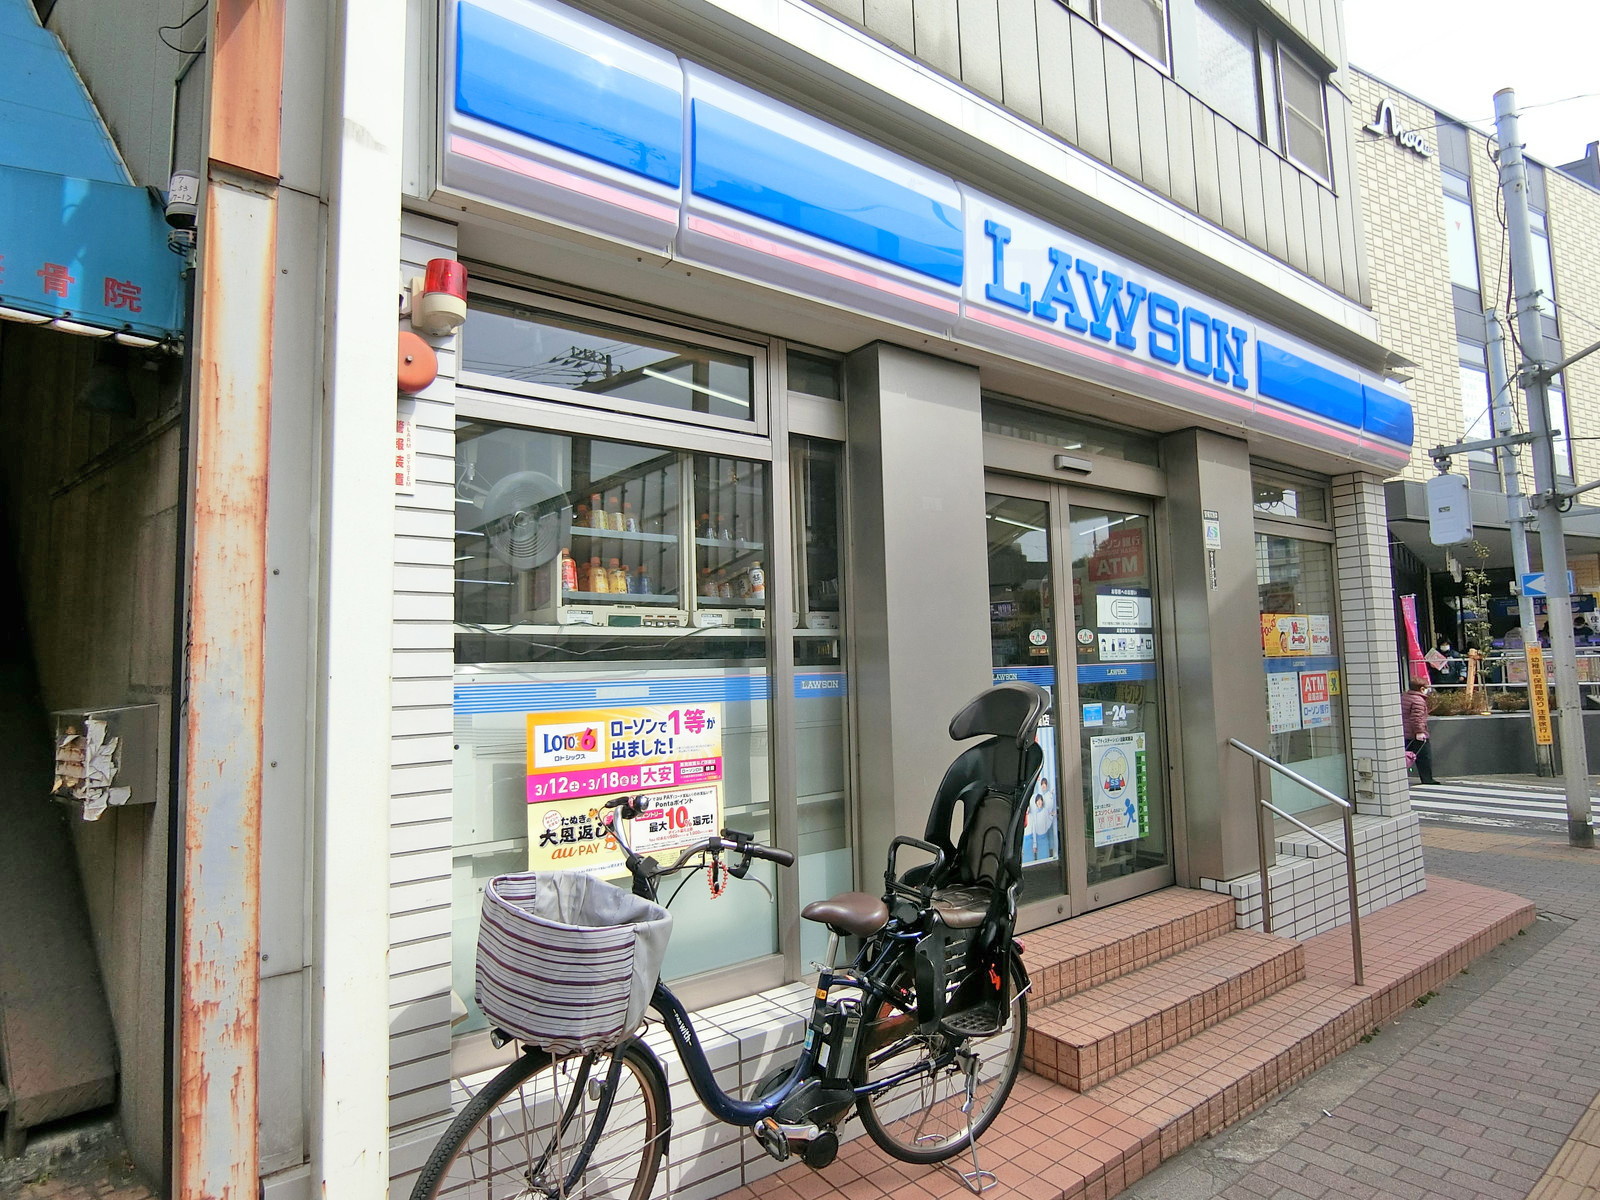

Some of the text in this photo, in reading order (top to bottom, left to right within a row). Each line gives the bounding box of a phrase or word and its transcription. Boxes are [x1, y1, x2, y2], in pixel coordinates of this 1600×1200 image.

[0, 255, 142, 313] 骨院
[984, 219, 1249, 391] LAWSON
[1096, 555, 1138, 576] ATM
[991, 673, 1018, 681] LAWSON
[1106, 668, 1128, 676] LAWSON
[801, 680, 839, 689] LAWSON
[1304, 676, 1325, 692] ATM
[1112, 704, 1127, 720] 24
[1303, 704, 1329, 716] ローソン銀行
[611, 709, 715, 737] ローソンで1等が
[611, 737, 674, 760] 出ました!
[554, 753, 586, 762] ロトシックス
[643, 766, 672, 784] 大安
[560, 815, 591, 826] たぬきの
[539, 822, 608, 848] 大恩返し
[551, 843, 600, 860] au PAY
[679, 1022, 692, 1043] with
